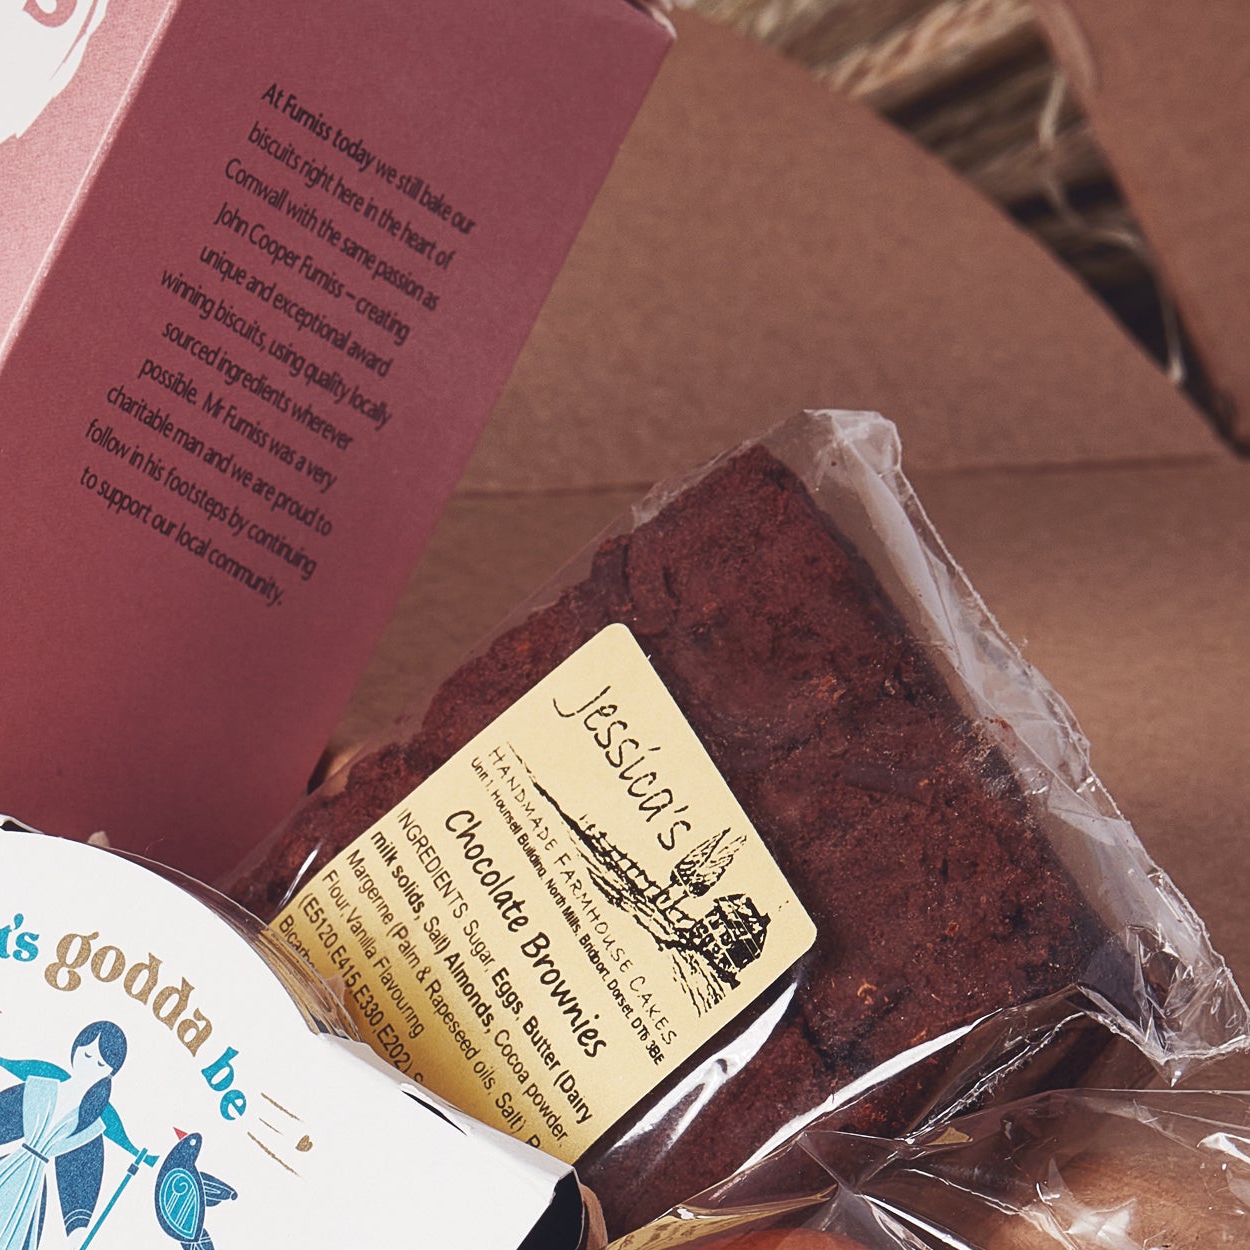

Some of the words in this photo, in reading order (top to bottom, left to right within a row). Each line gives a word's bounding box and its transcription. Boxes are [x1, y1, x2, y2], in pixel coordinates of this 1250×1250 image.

[224, 157, 289, 211] Cornwall
[285, 199, 318, 232] with
[316, 217, 341, 247] the
[339, 236, 376, 270] same
[371, 259, 424, 301] passion
[421, 291, 440, 311] as
[247, 120, 302, 170] biscuits
[298, 157, 334, 193] right
[331, 175, 364, 212] here
[362, 196, 379, 221] in
[377, 207, 401, 237] the
[398, 220, 436, 260] heart
[434, 250, 456, 270] of
[260, 82, 284, 109] At
[281, 93, 333, 141] Furniss
[331, 128, 376, 173] today
[374, 158, 397, 184] we
[395, 174, 424, 200] still
[418, 183, 452, 221] bake
[450, 211, 476, 234] our
[160, 269, 216, 320] winning
[267, 339, 306, 377] using
[303, 362, 351, 403] quality
[347, 385, 392, 428] locally
[198, 245, 247, 285] unique
[244, 275, 277, 303] and
[271, 292, 352, 350] exceptional
[346, 340, 393, 378] award
[212, 201, 249, 237] John
[248, 223, 301, 269] Cooper
[297, 254, 345, 298] Furniss
[355, 296, 411, 346] creating
[106, 384, 174, 438] charitable
[171, 427, 205, 457] man
[202, 447, 234, 474] and
[230, 462, 253, 488] we
[251, 477, 275, 501] are
[270, 490, 319, 526] proud
[314, 514, 332, 536] to
[161, 321, 222, 366] sourced
[215, 350, 292, 413] ingredients
[290, 401, 353, 450] wherever
[200, 391, 226, 419] Mr
[221, 403, 269, 448] Furniss
[268, 437, 296, 465] was
[294, 455, 307, 472] a
[306, 460, 337, 493] very
[80, 465, 98, 490] to
[96, 479, 152, 524] support
[150, 513, 177, 537] our
[174, 521, 212, 558] local
[84, 417, 131, 459] follow
[128, 444, 144, 470] in
[141, 452, 165, 481] his
[162, 466, 230, 521] footsteps
[226, 505, 250, 536] by
[246, 523, 316, 580] continuing
[553, 685, 692, 852] Jessica's
[370, 830, 398, 867] milk
[423, 915, 451, 955] Salt)
[493, 1028, 529, 1085] Cocoa
[444, 809, 529, 932] Chocolate
[519, 931, 607, 1058] Brownies
[488, 746, 557, 850] HANDMADE
[553, 852, 633, 972] FARMHOUSE
[629, 975, 677, 1045] CAKES
[44, 931, 213, 1057] godda
[201, 1046, 247, 1120] be
[345, 910, 376, 959] Vanilla
[372, 955, 425, 1039] Flavouring
[345, 848, 394, 925] Margerine
[385, 921, 420, 969] (Palm
[415, 965, 431, 984] &
[424, 978, 481, 1060] Rapeseed
[494, 1091, 526, 1137] Salt)
[521, 1014, 561, 1071] Butter
[552, 1069, 593, 1124] (Dairy
